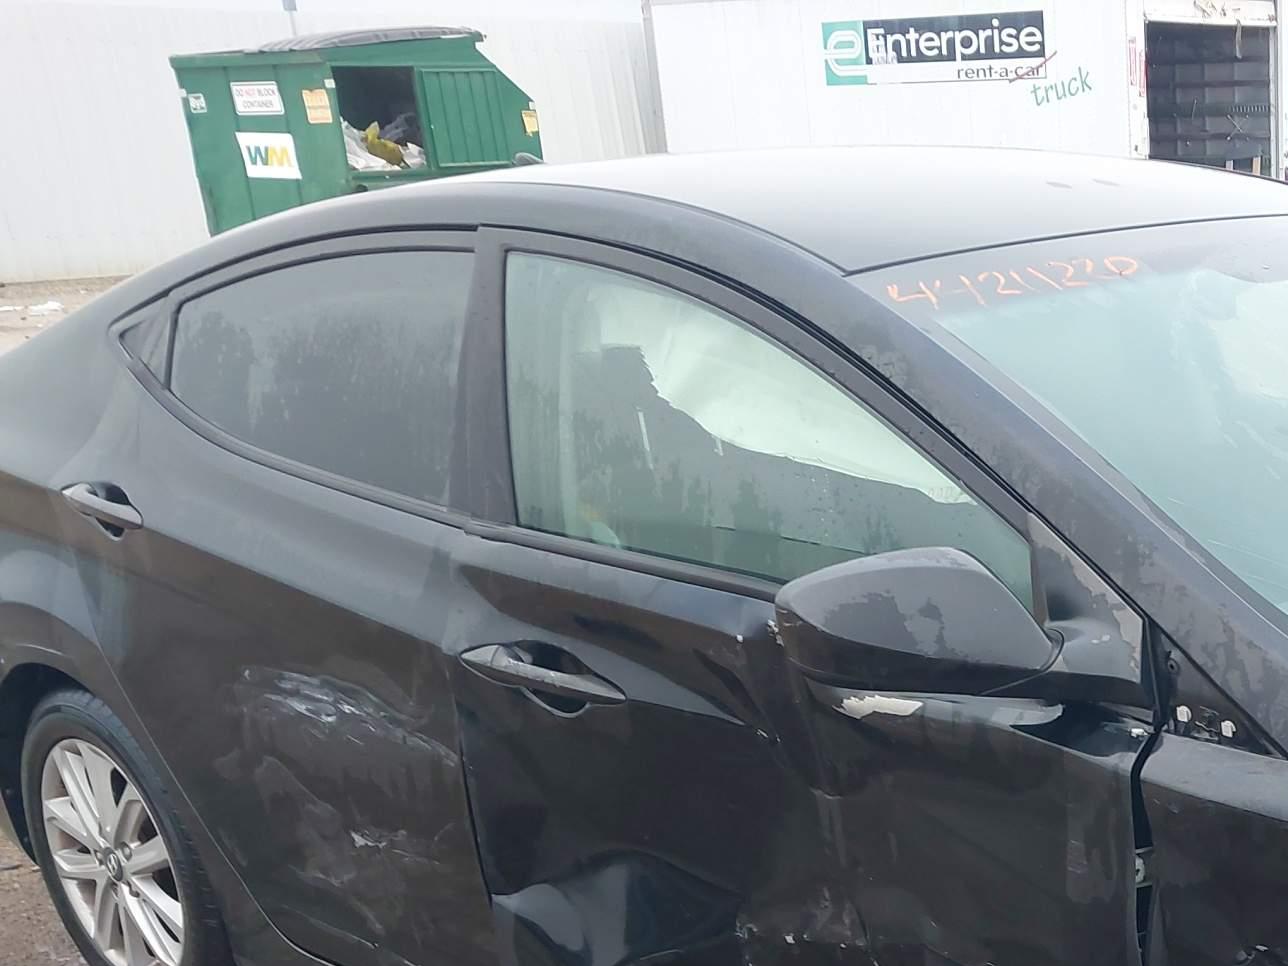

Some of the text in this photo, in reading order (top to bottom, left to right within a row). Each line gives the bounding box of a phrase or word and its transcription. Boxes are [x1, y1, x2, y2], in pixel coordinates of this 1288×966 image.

[867, 18, 1043, 62] Enterprise
[956, 63, 1044, 80] rent-a-car
[257, 87, 276, 97] BLOCK
[1030, 65, 1093, 107] truck
[241, 99, 274, 109] CONTAINER
[246, 145, 294, 168] WM
